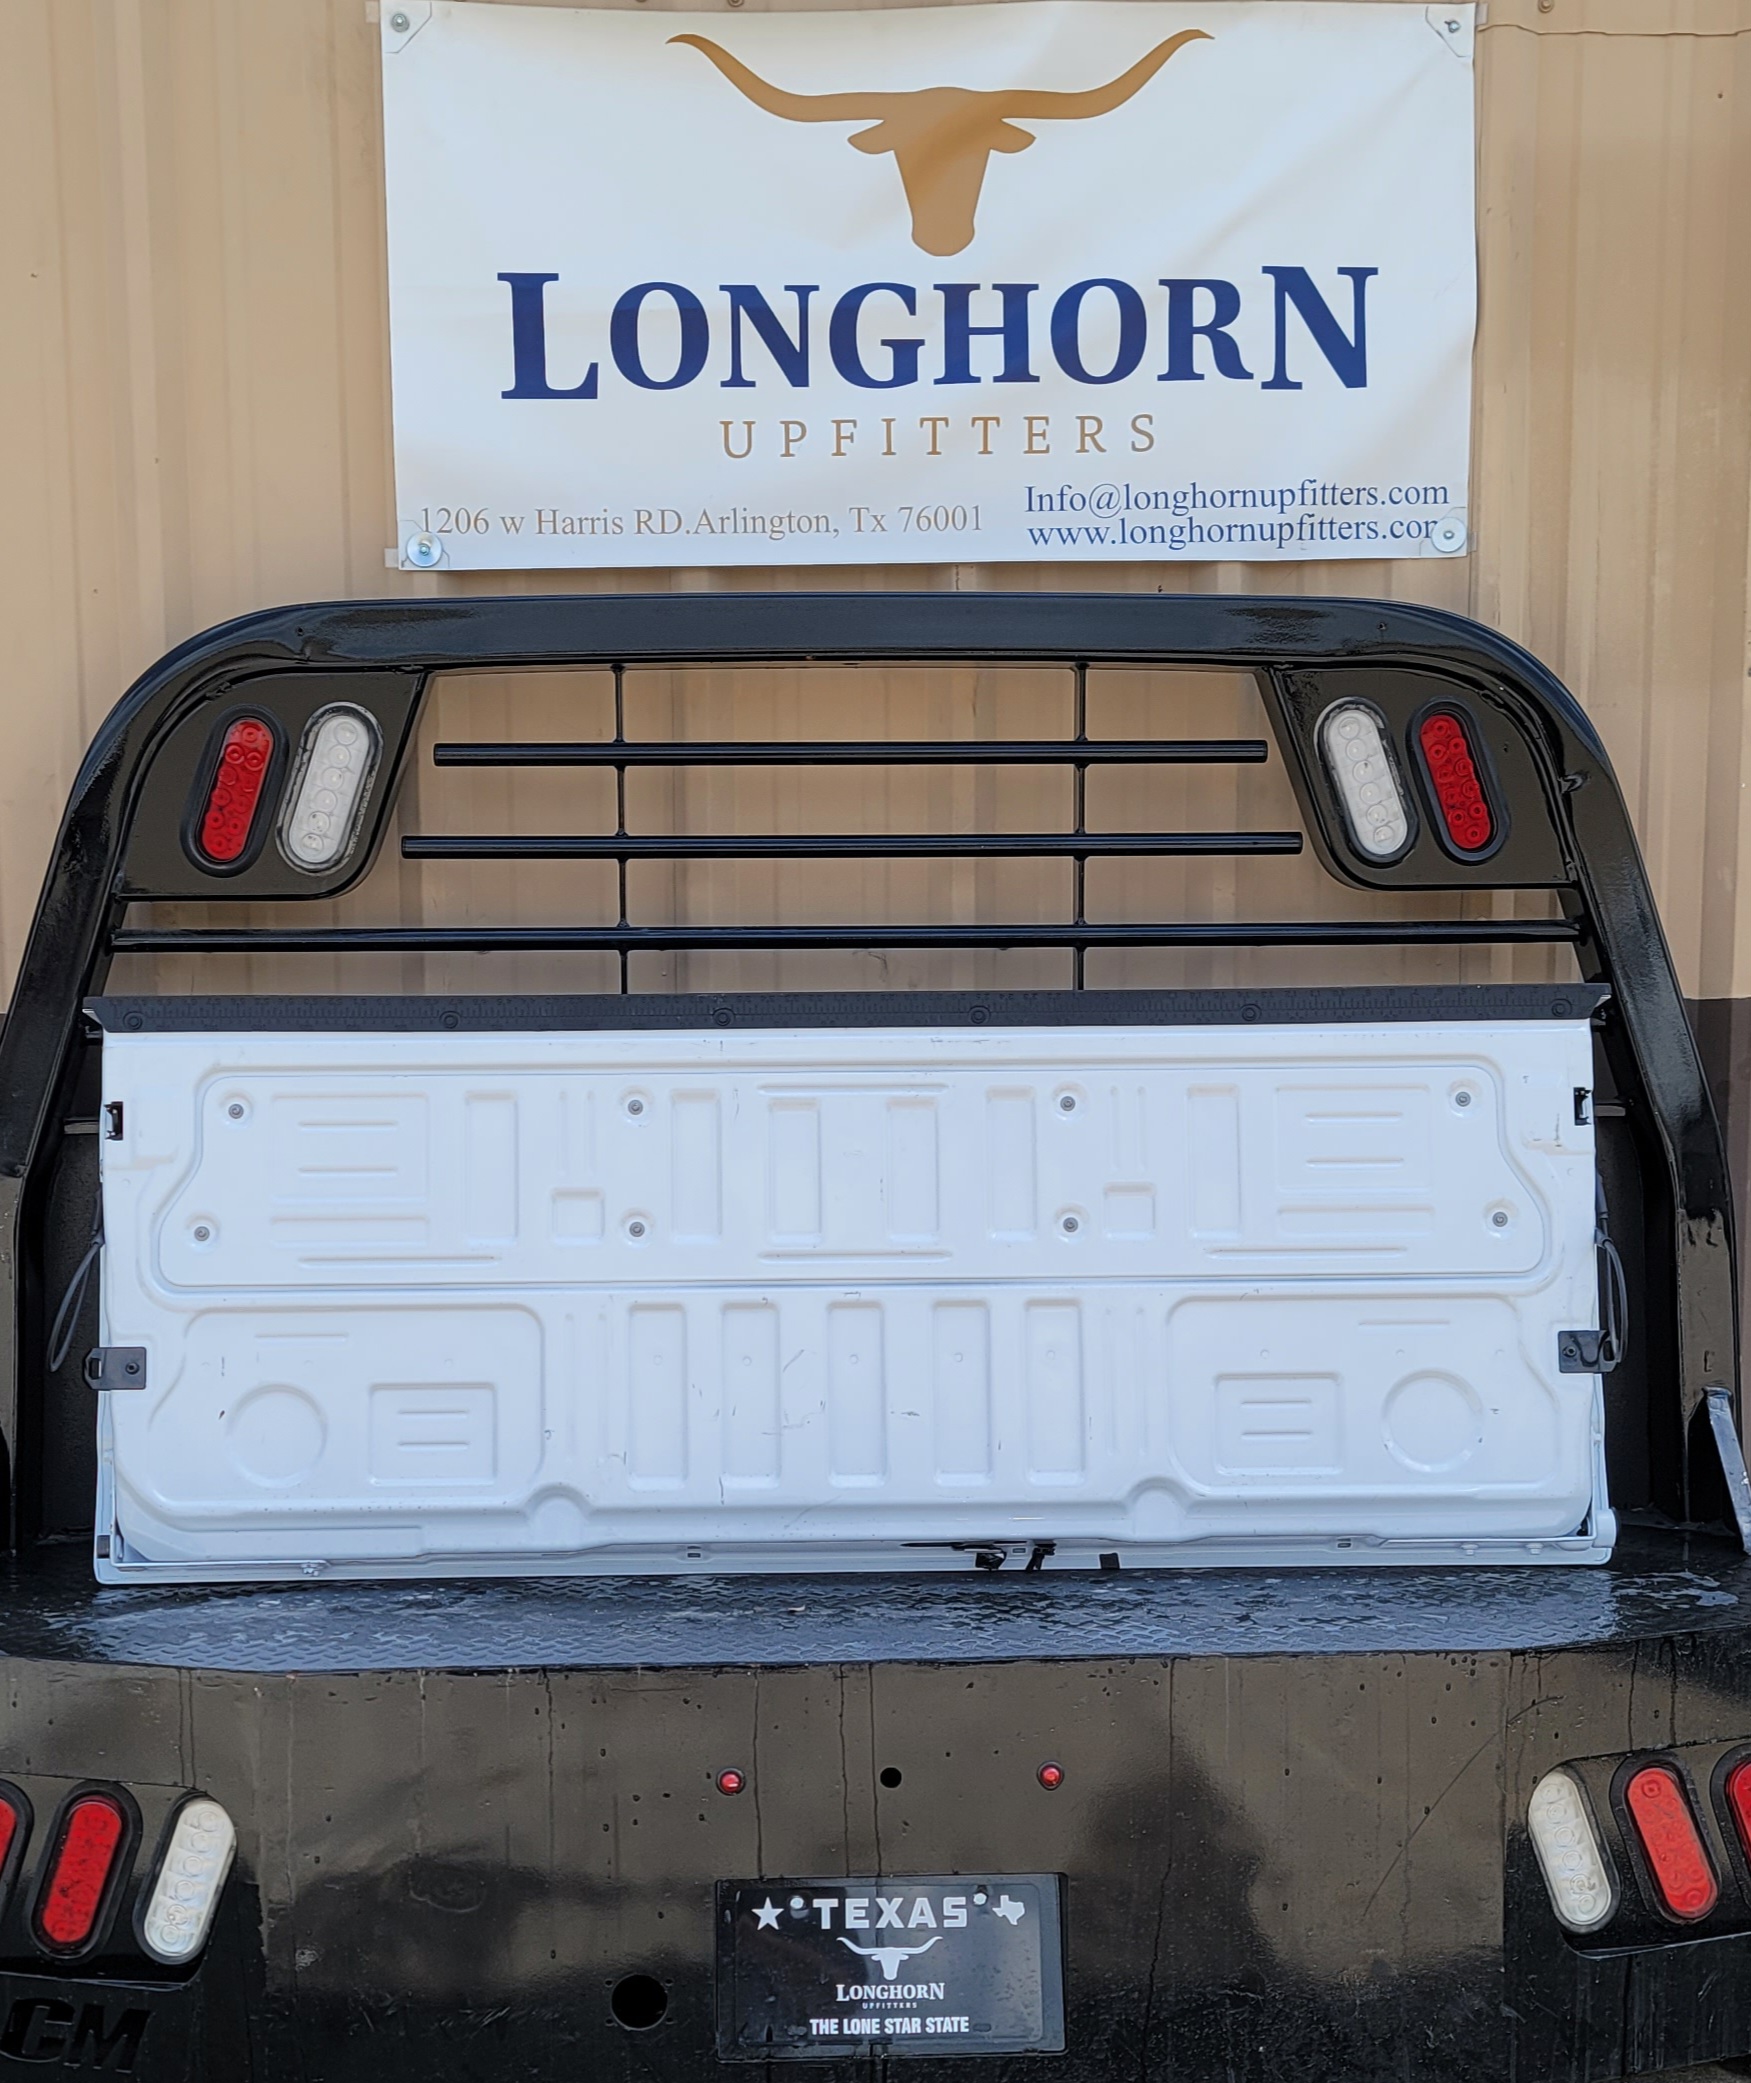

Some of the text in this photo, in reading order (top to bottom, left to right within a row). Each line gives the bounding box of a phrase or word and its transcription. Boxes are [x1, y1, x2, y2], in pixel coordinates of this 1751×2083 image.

[496, 265, 1379, 400] LONGHORN
[719, 413, 1156, 459] UPFITTERS
[1024, 479, 1449, 519] Info@longhornupfitters.com
[421, 507, 490, 534] 1206
[499, 516, 525, 534] w
[535, 508, 624, 535] Harris
[848, 507, 888, 533] Tx
[898, 505, 983, 532] 76001
[812, 1896, 968, 1930] TEXAS
[835, 1982, 946, 2002] LONGHORN
[1, 1997, 150, 2073] CM
[809, 2016, 970, 2036] THE LONE STAR STATE
